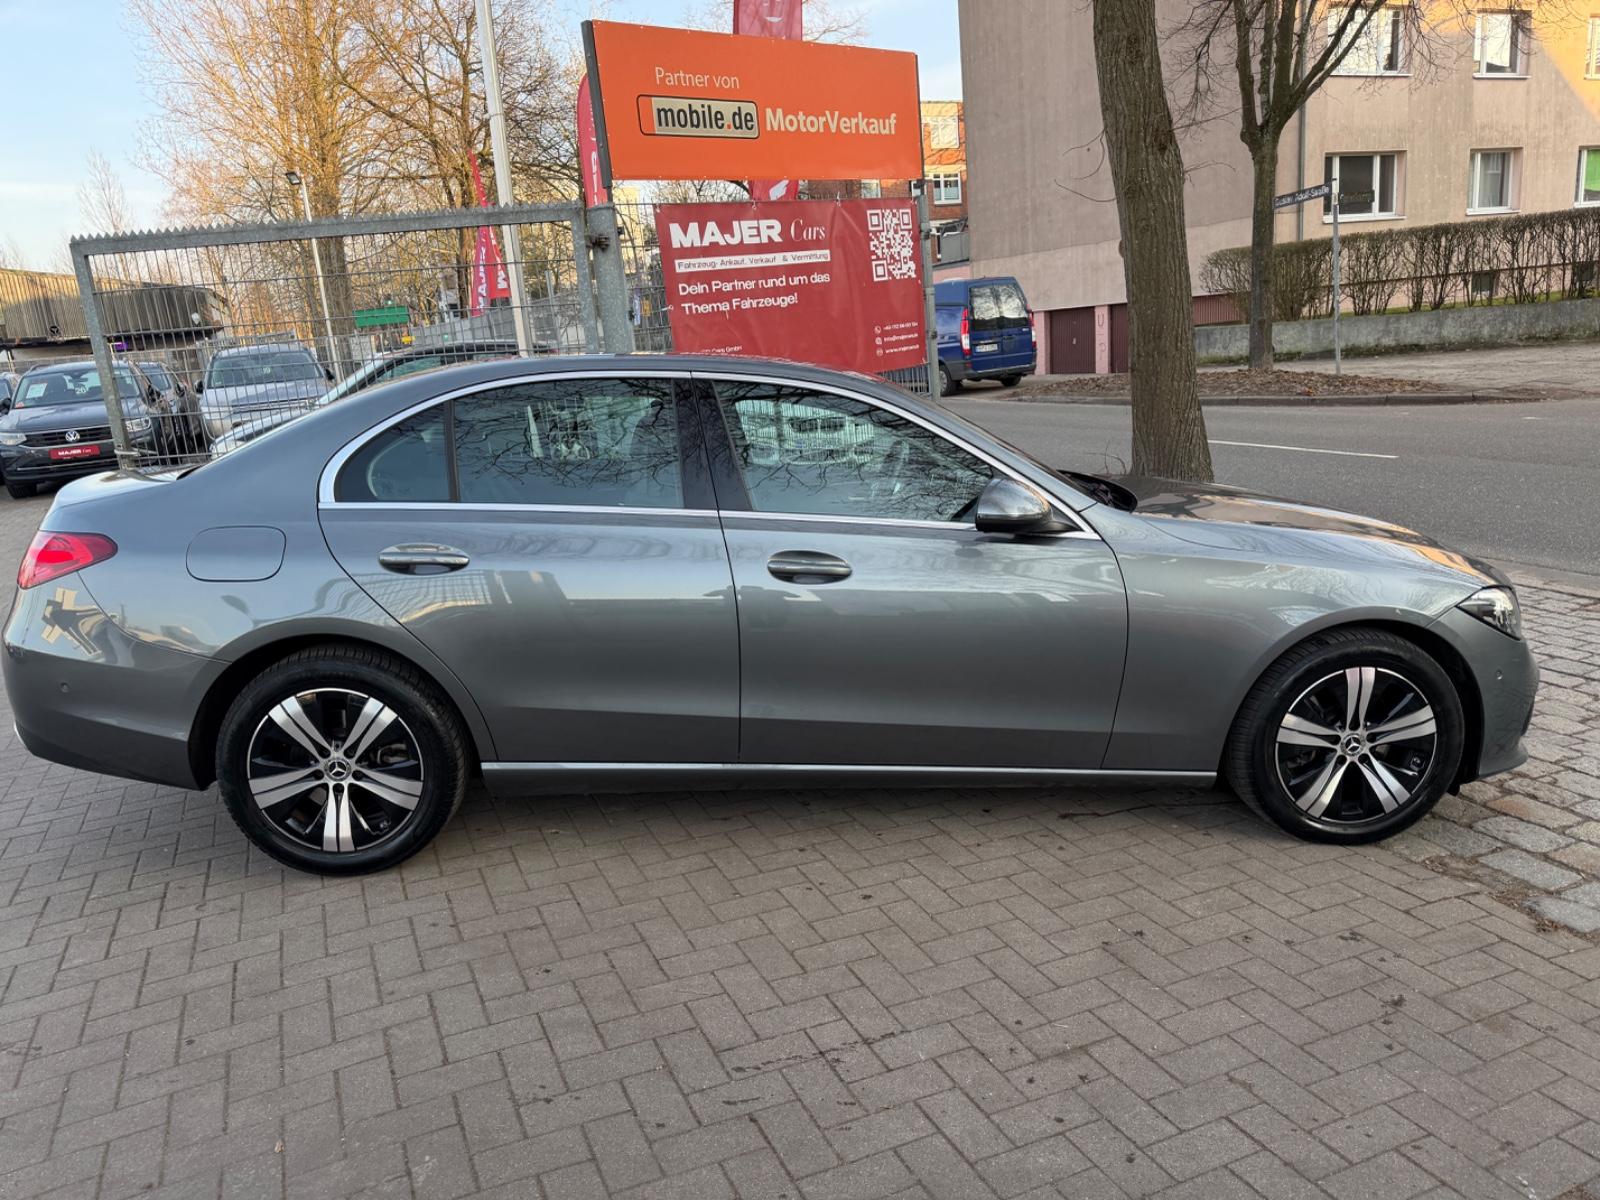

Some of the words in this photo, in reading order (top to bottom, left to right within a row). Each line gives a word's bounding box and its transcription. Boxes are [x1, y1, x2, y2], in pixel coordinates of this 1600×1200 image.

[655, 67, 710, 89] Partner
[713, 76, 740, 89] von
[656, 103, 755, 131] mobile.de
[765, 107, 897, 136] MotorVerkauf
[669, 219, 783, 248] MAJER
[790, 217, 826, 242] Cars
[678, 282, 709, 296] Dein
[711, 278, 756, 294] Partner
[758, 275, 786, 289] rund
[789, 275, 807, 285] um
[809, 272, 830, 284] das
[681, 299, 730, 315] Thema
[732, 293, 799, 312] Fahrzeuge!
